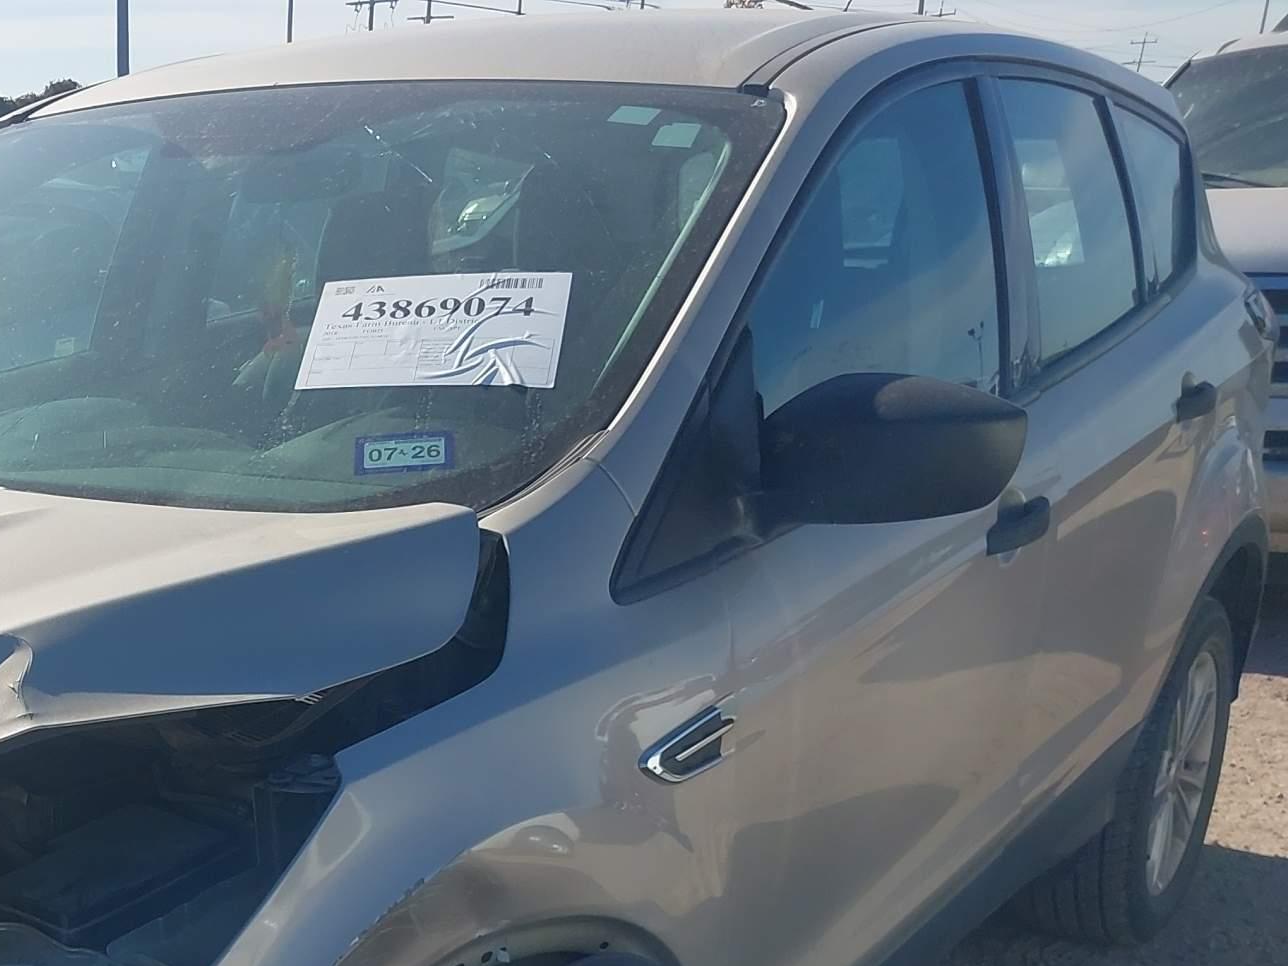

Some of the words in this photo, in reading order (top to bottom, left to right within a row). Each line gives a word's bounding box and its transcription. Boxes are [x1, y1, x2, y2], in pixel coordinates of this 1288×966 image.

[341, 296, 536, 322] 43869074
[368, 447, 398, 462] 07
[411, 444, 441, 460] 26
